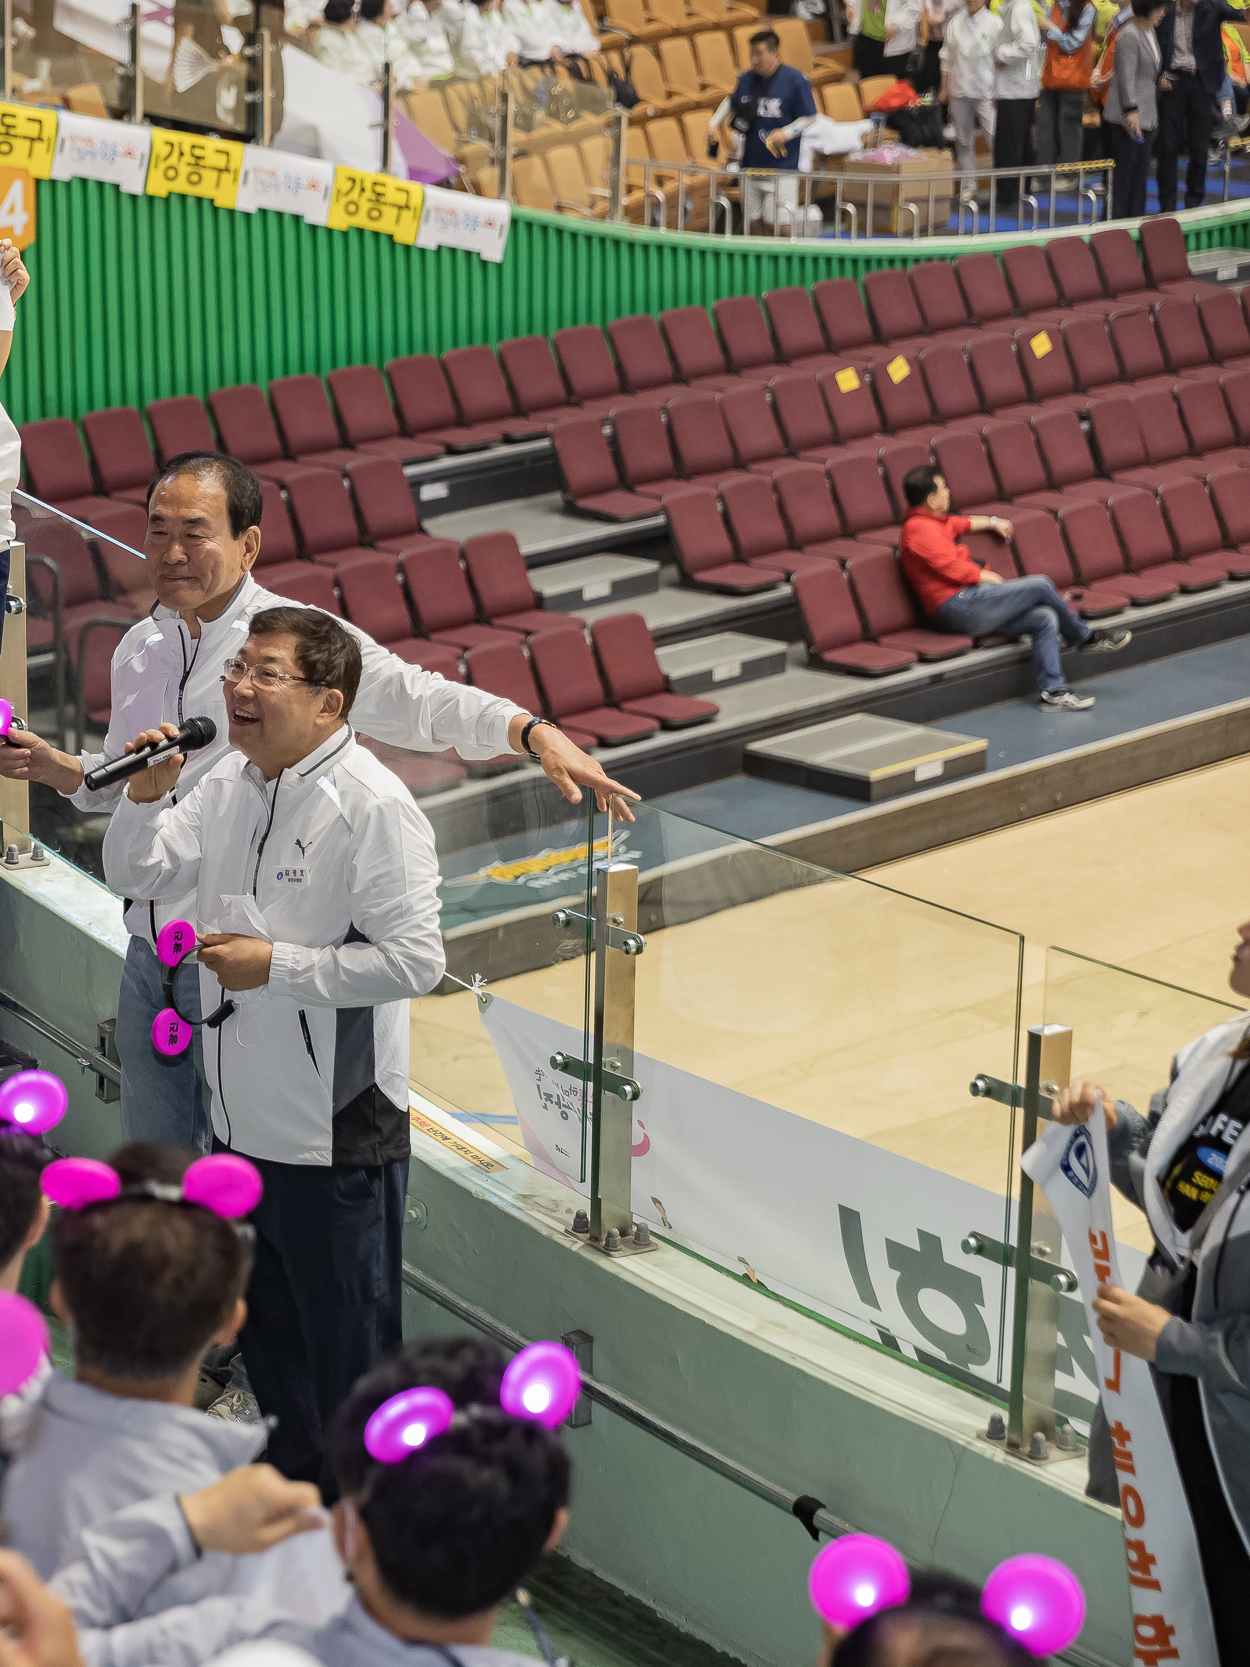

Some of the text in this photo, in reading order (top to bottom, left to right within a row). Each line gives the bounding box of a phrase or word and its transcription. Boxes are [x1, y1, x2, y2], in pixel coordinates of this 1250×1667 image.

[162, 140, 232, 190] 강동구
[342, 176, 411, 226] 강동구
[173, 930, 184, 954] 광진
[168, 1021, 180, 1046] 광진
